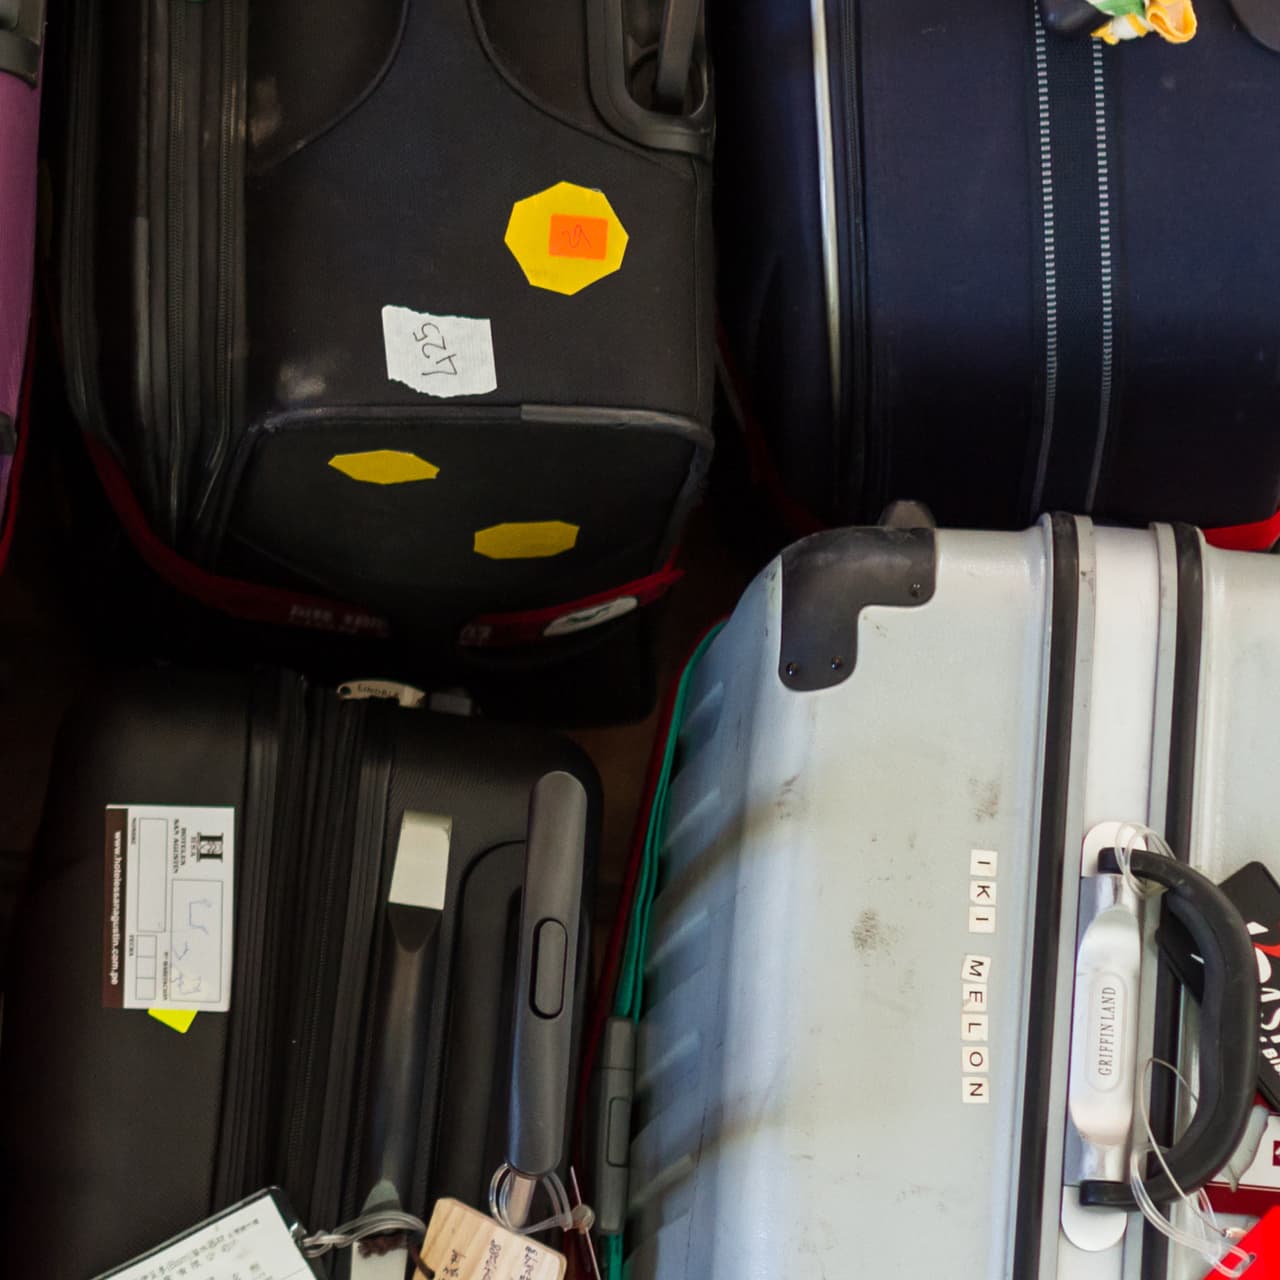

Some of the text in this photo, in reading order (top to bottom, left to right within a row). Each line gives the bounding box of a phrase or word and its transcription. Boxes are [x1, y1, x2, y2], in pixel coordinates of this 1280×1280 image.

[412, 322, 459, 377] 425
[975, 860, 991, 922] IKI
[968, 959, 985, 1097] MELON
[1097, 986, 1117, 1077] GRIFFIN LAND
